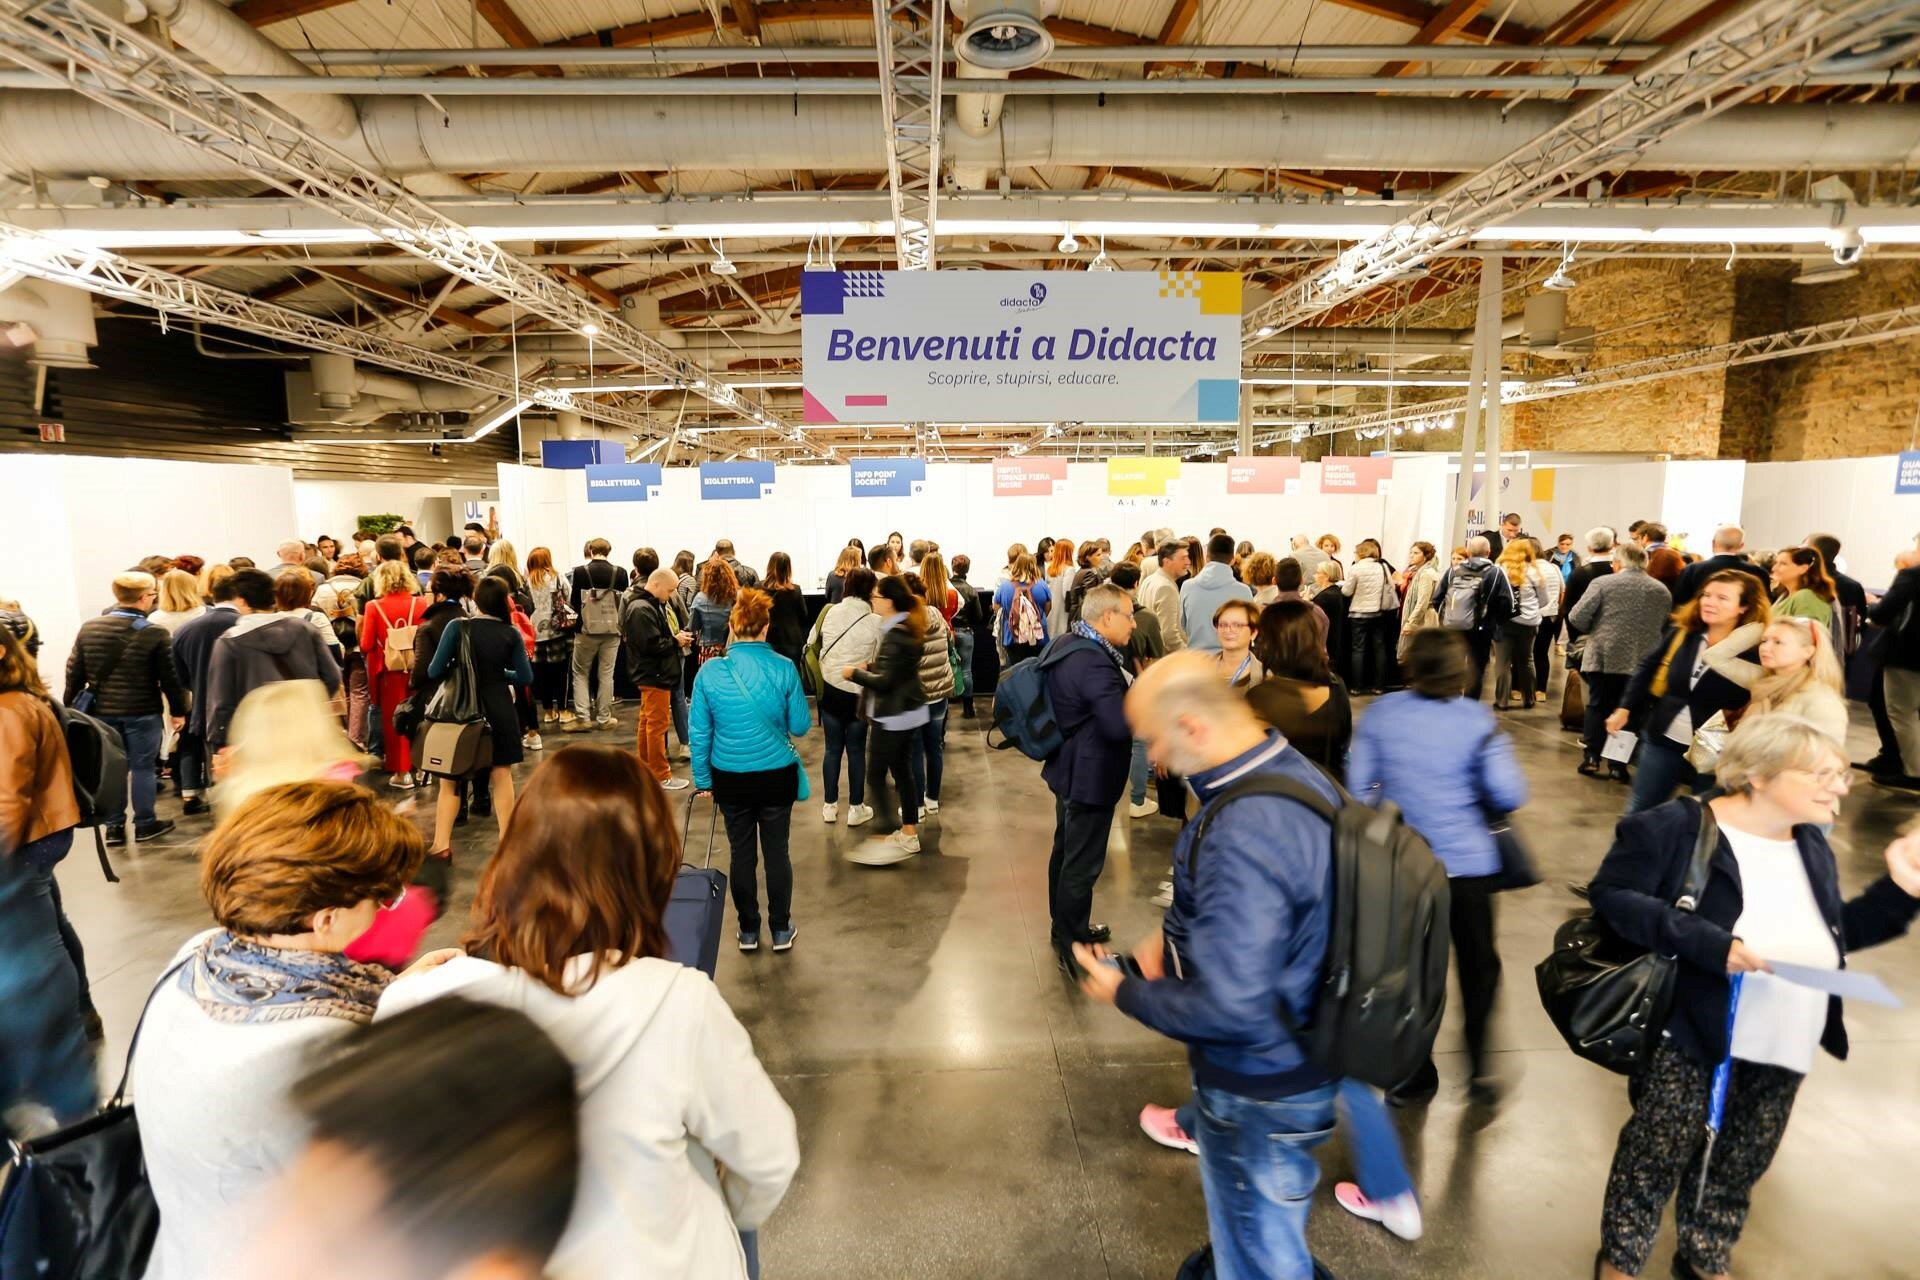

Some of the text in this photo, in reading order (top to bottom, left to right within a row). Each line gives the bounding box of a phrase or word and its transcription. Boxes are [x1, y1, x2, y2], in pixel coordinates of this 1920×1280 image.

[1000, 297, 1039, 306] didacta
[827, 326, 1217, 361] Benvenuti a Didacta
[928, 371, 1119, 388] Scoprire, stupirsi, educare.
[874, 470, 896, 478] POINT
[590, 478, 641, 487] BIGLIETTERIA
[704, 477, 754, 486] BIGLIETTERIA
[855, 478, 887, 486] DOCENTI
